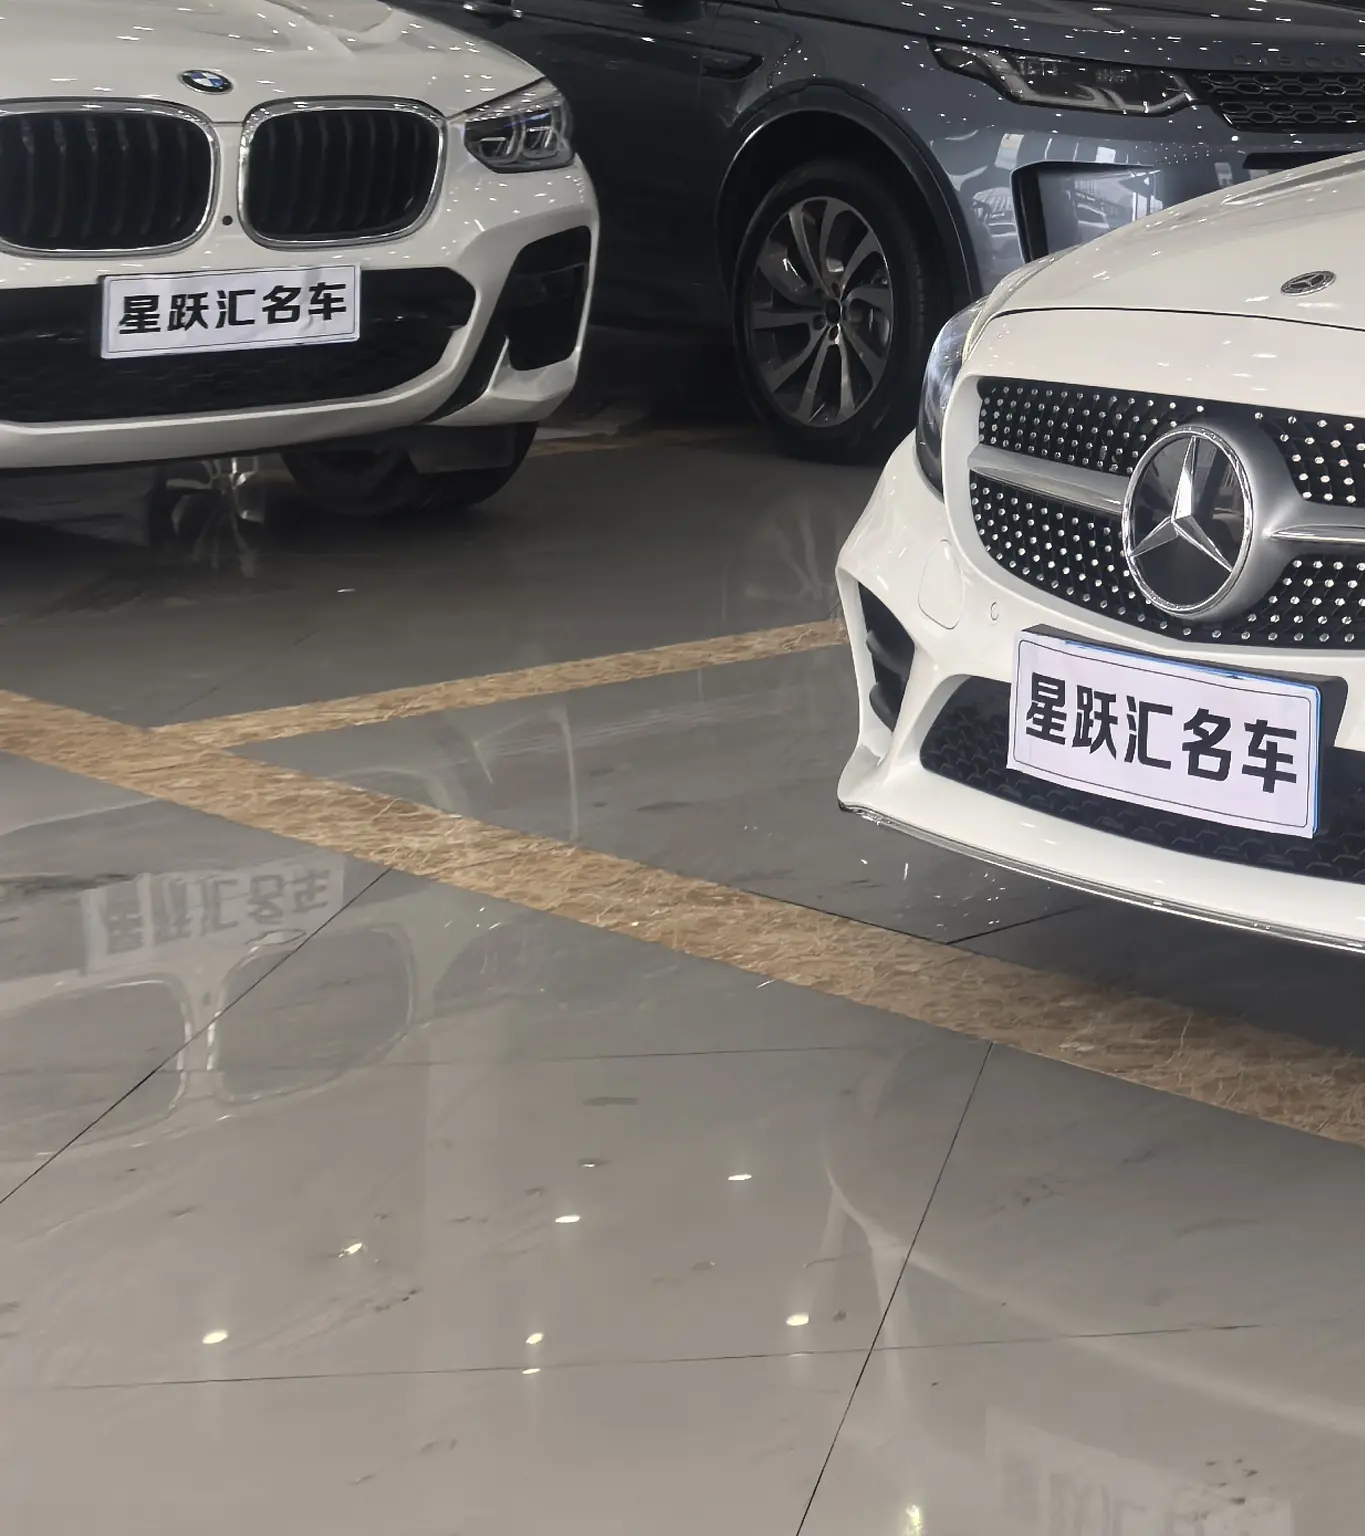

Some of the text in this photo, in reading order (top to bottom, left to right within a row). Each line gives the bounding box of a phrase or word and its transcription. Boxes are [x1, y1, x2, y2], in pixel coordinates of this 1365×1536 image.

[117, 281, 348, 335] 星跃汇名车
[1025, 671, 1298, 794] 星跃汇名车
